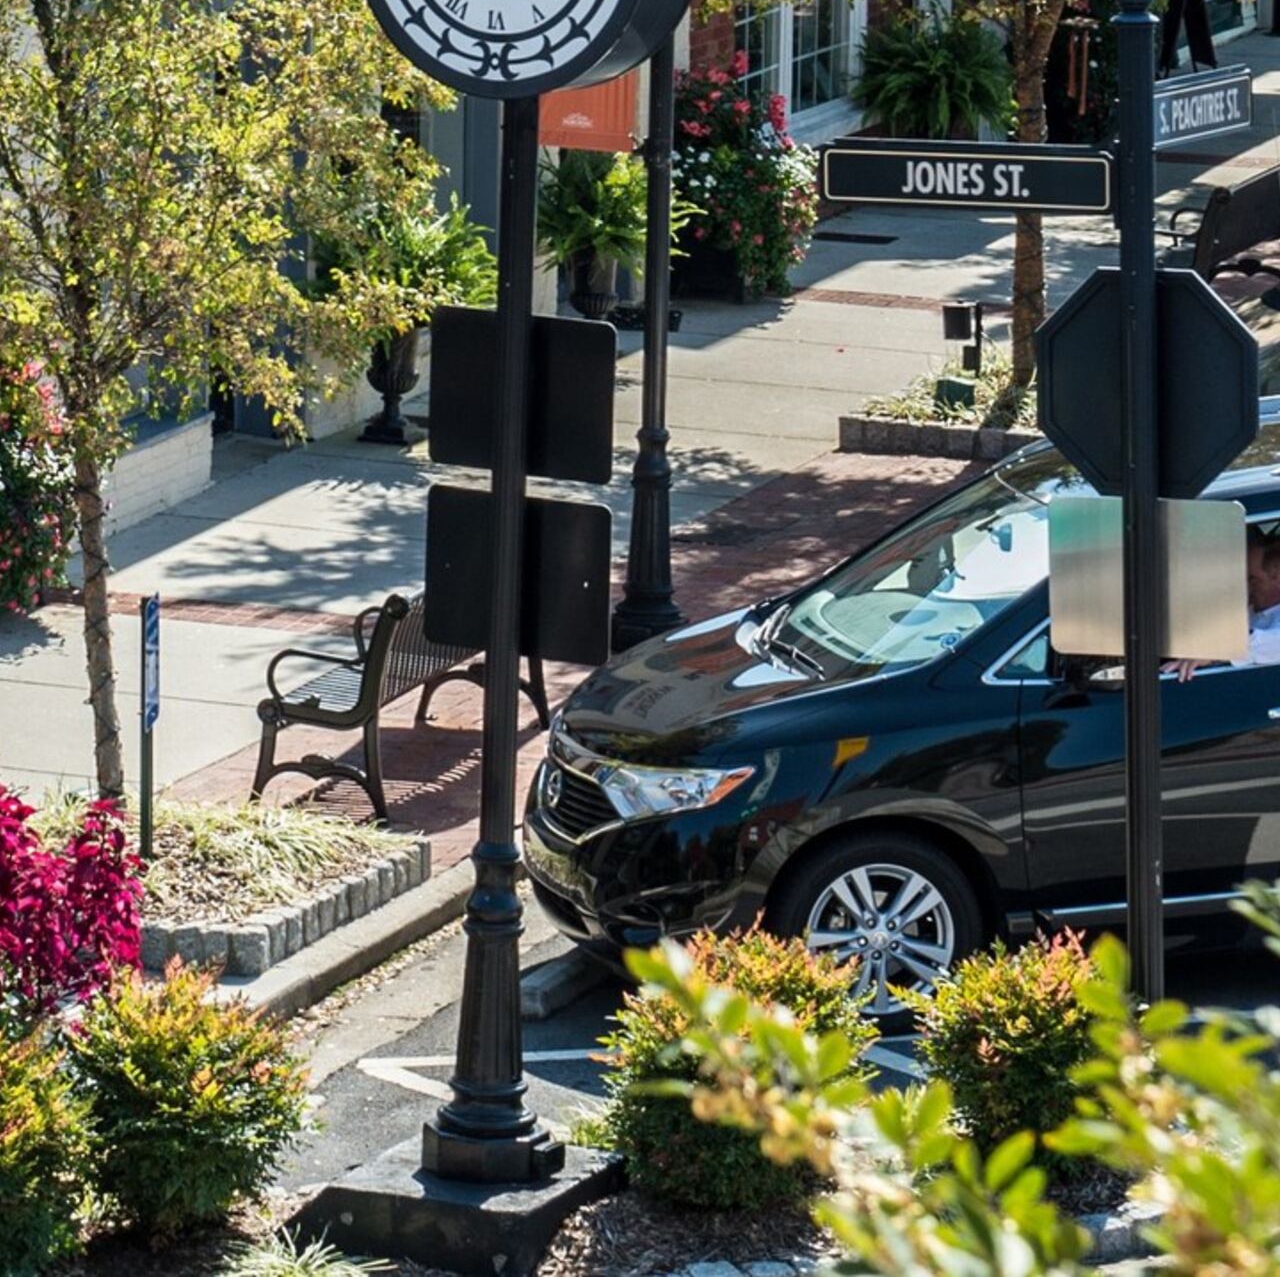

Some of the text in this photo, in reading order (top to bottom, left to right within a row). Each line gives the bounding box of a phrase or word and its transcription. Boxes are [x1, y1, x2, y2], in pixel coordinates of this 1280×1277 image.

[487, 10, 505, 31] VI
[532, 4, 546, 24] V
[1160, 87, 1241, 134] S. PEACHTREE ST.
[901, 160, 1031, 198] JONES ST.
